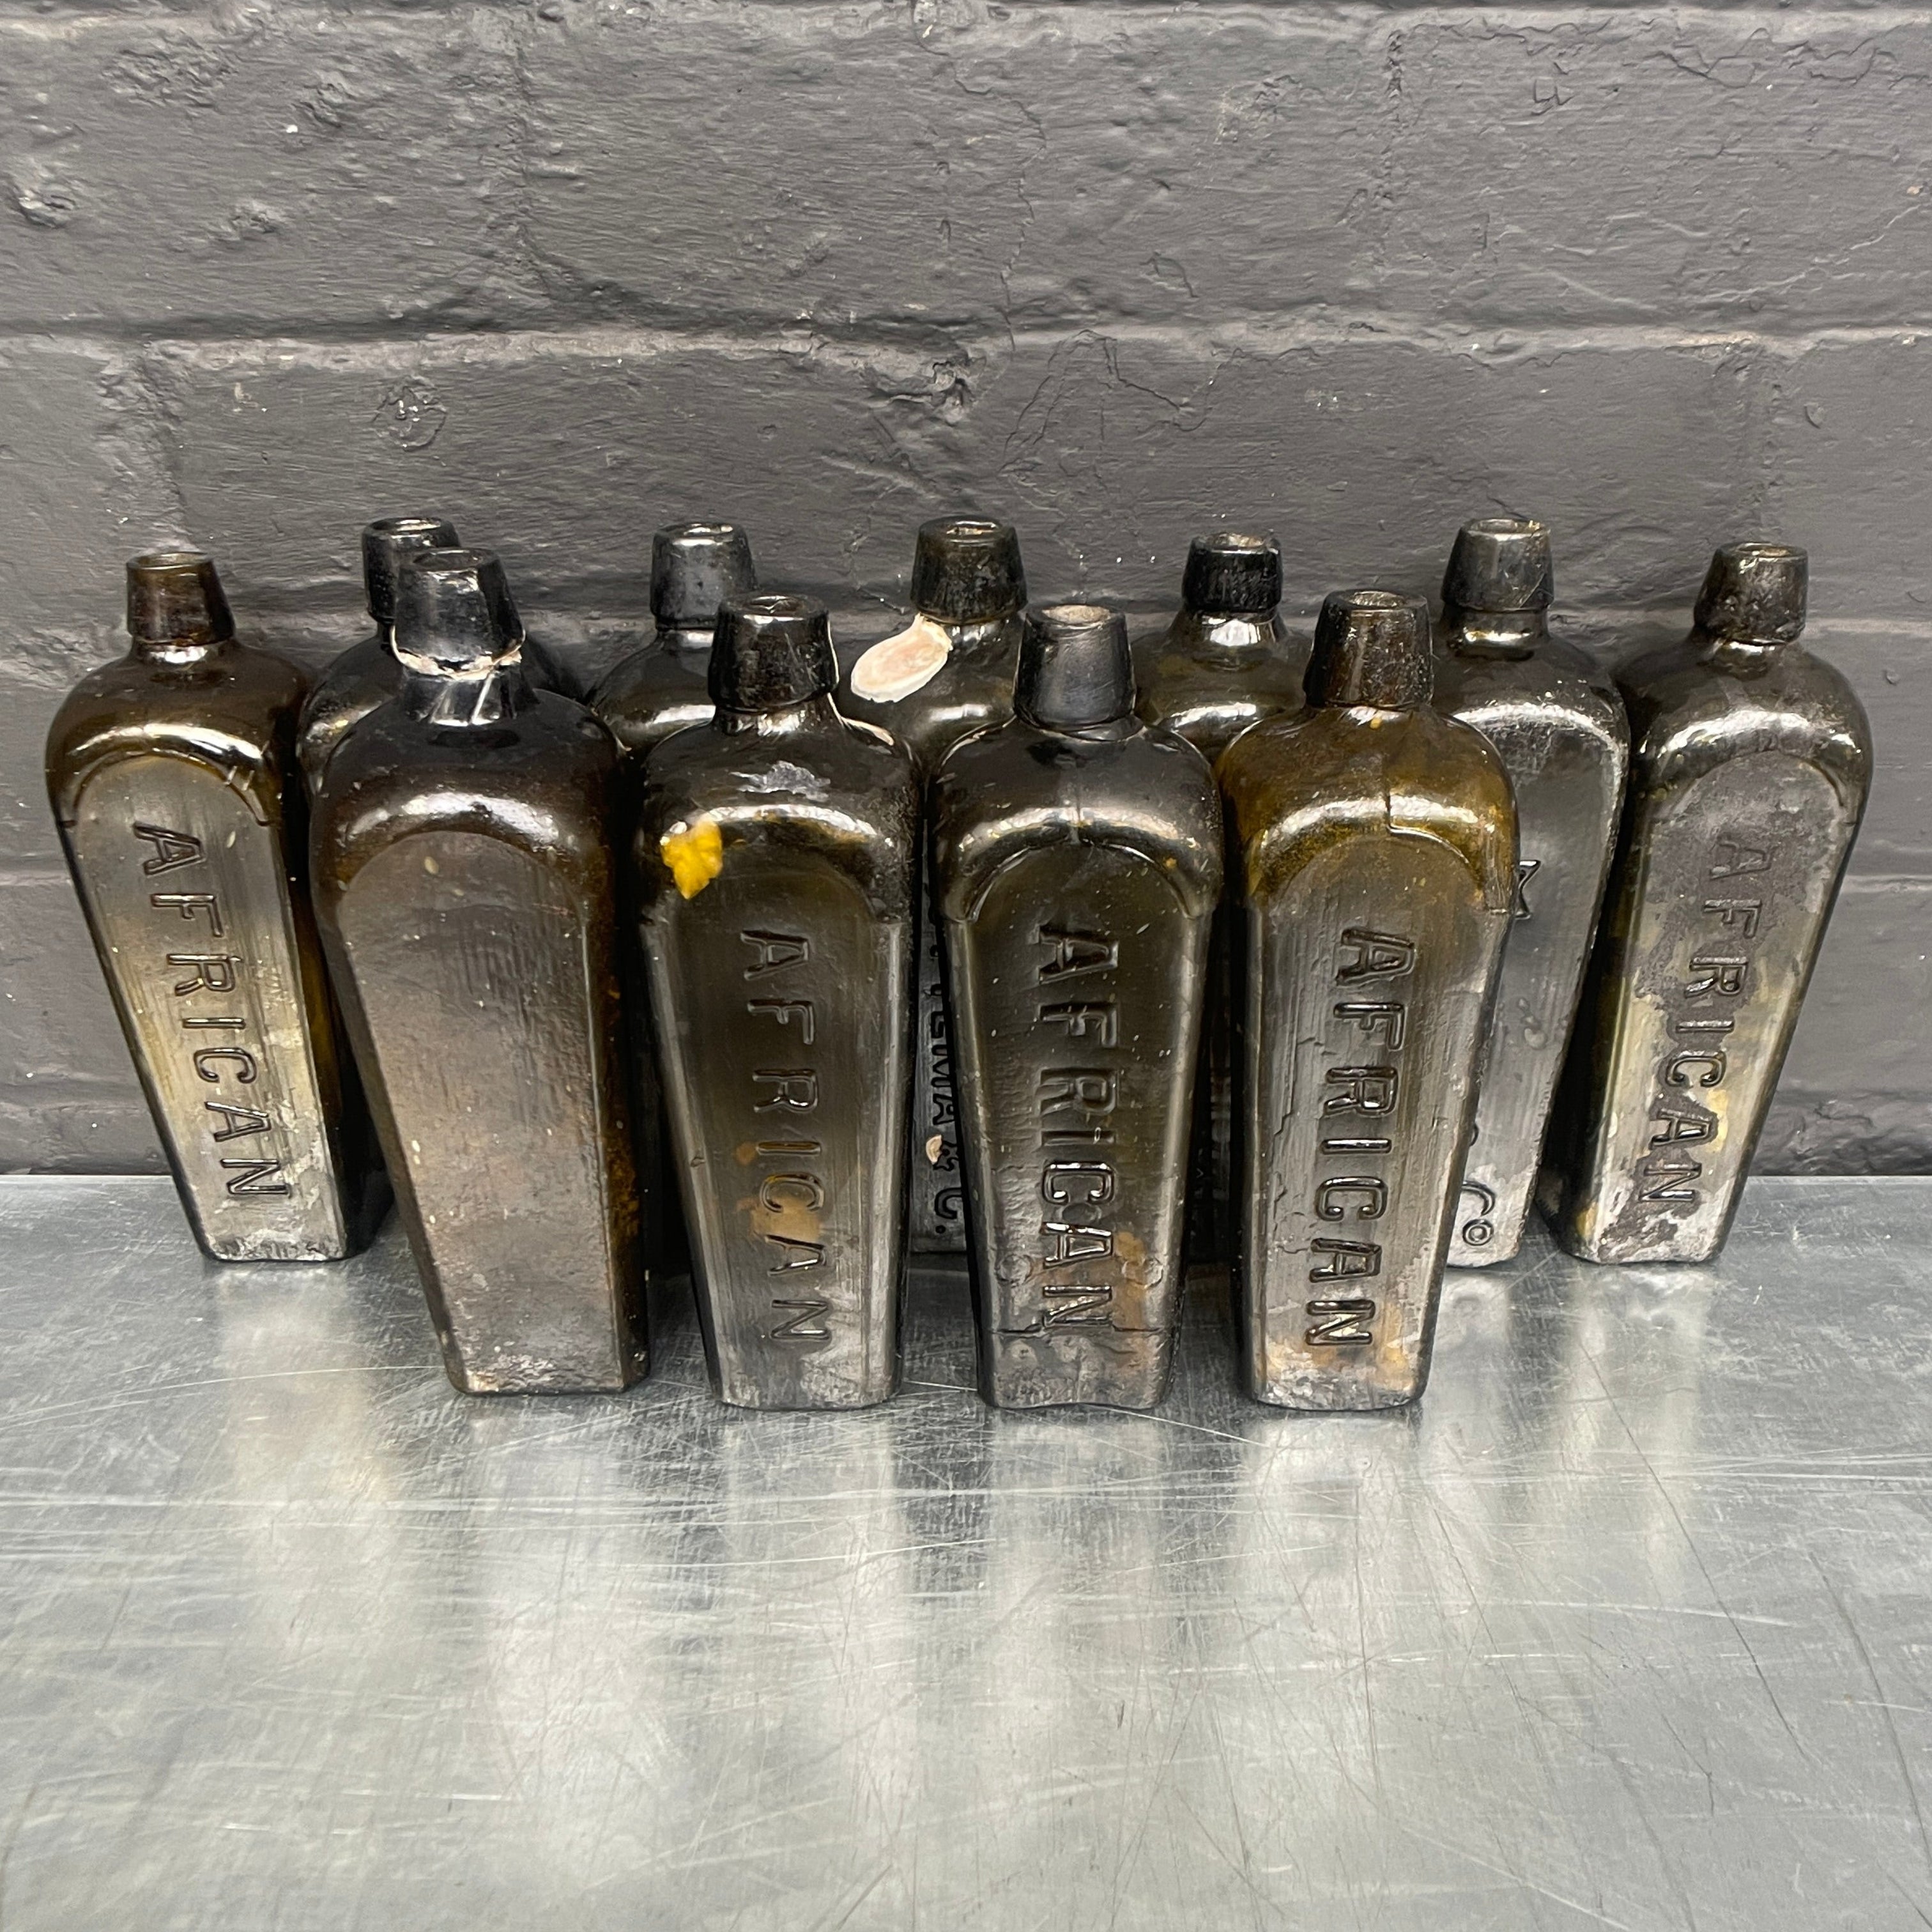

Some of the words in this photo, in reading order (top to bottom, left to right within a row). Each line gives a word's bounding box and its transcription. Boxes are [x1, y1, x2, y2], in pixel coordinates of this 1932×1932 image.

[133, 822, 292, 1198] AFRICAN
[740, 928, 833, 1342] AFRICAN
[1037, 924, 1120, 1329] AFRICAN
[1305, 926, 1415, 1346] AFRICAN
[1637, 839, 1773, 1203] AFRICAN
